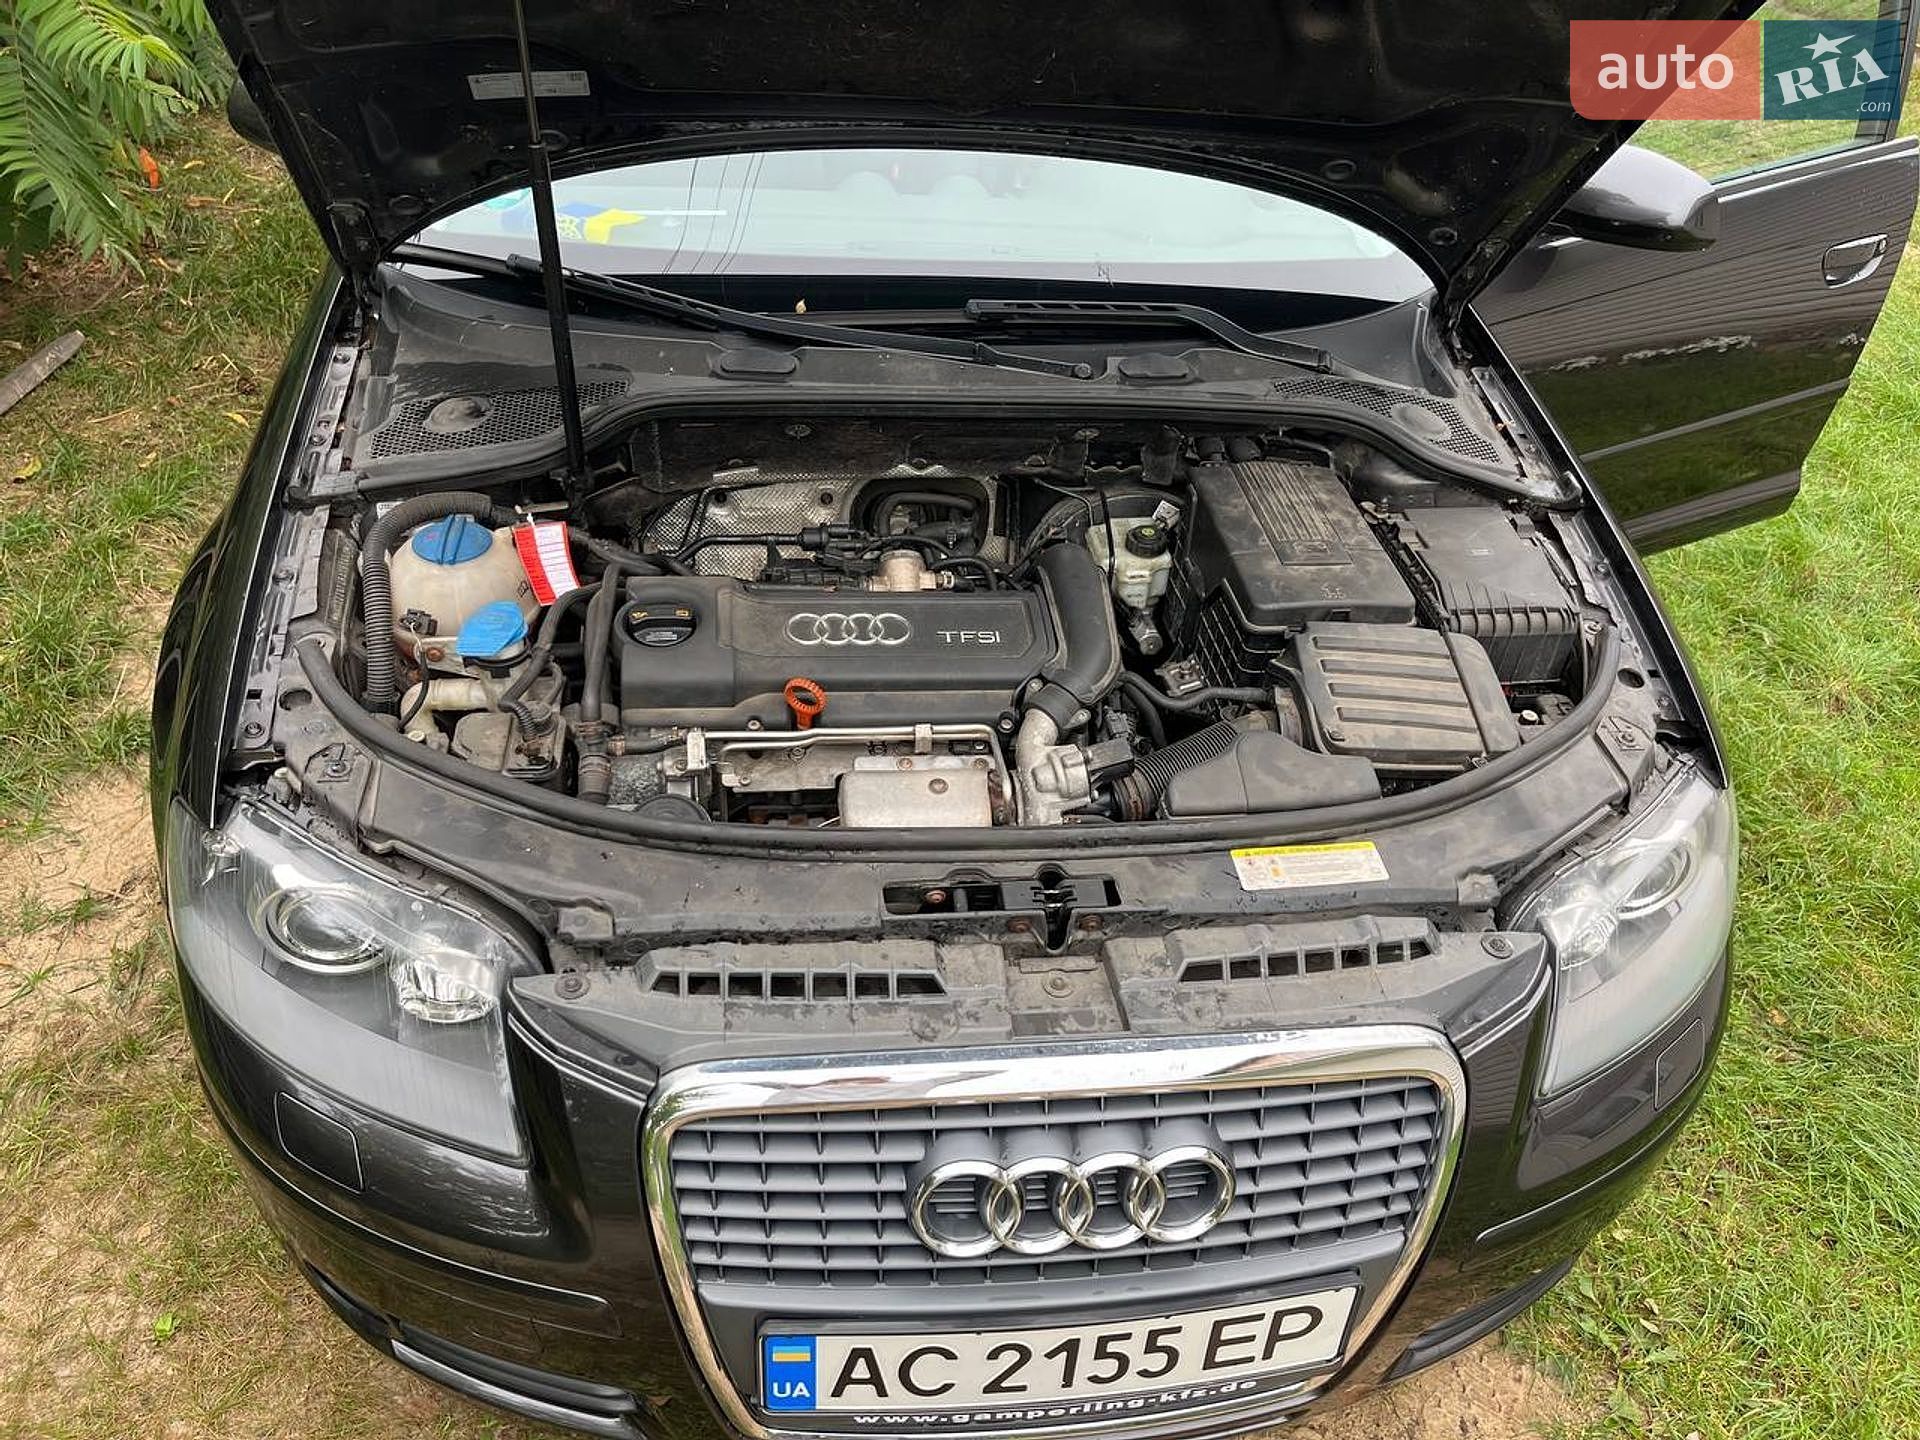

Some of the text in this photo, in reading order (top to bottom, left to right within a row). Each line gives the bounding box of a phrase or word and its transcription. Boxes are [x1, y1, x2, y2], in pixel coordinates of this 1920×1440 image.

[936, 630, 1001, 645] TFSI
[829, 1304, 1325, 1399] AC 2155 EP
[772, 1381, 811, 1399] UA
[853, 1379, 1259, 1425] www.gamperling-kfz.de
